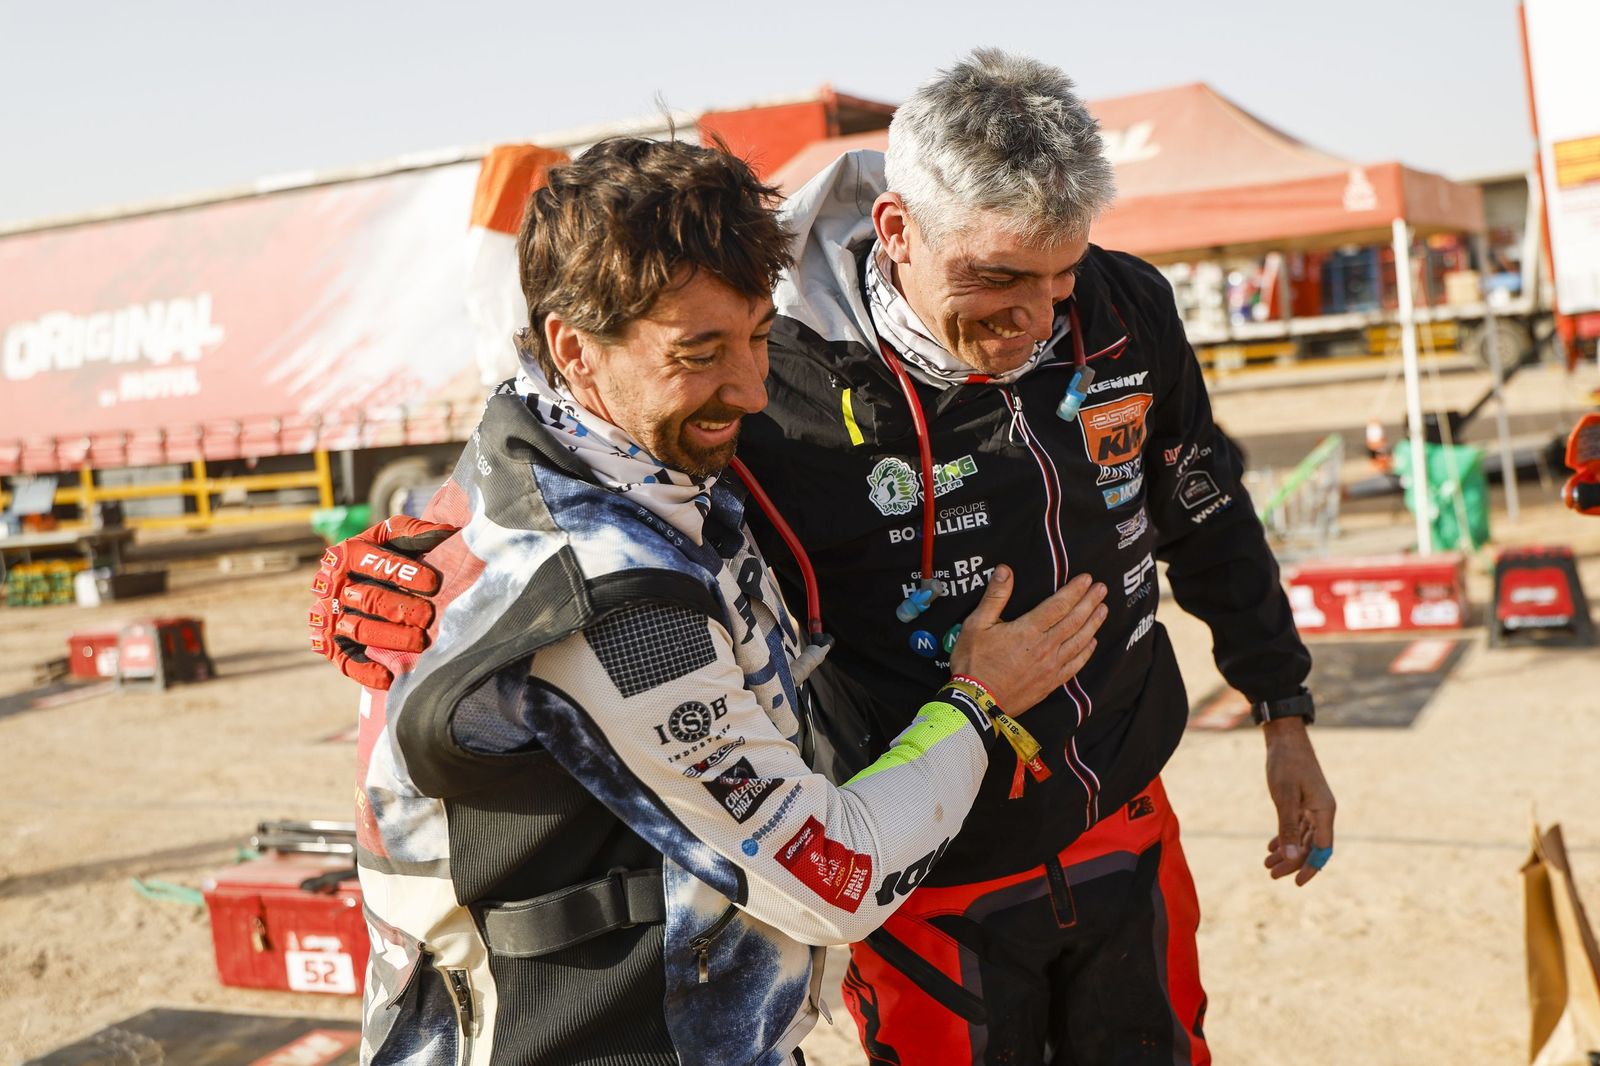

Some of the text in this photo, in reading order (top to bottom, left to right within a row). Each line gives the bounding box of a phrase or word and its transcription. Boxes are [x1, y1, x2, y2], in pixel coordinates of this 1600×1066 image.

[4, 293, 224, 380] ORIGINAL
[940, 501, 986, 519] GROUPE
[889, 512, 989, 544] BOLLIER
[360, 553, 418, 581] FIVE
[911, 556, 984, 580] GRUPE RP
[902, 567, 996, 598] HBITAT
[731, 793, 754, 820] DIAZ
[305, 960, 337, 985] 52
